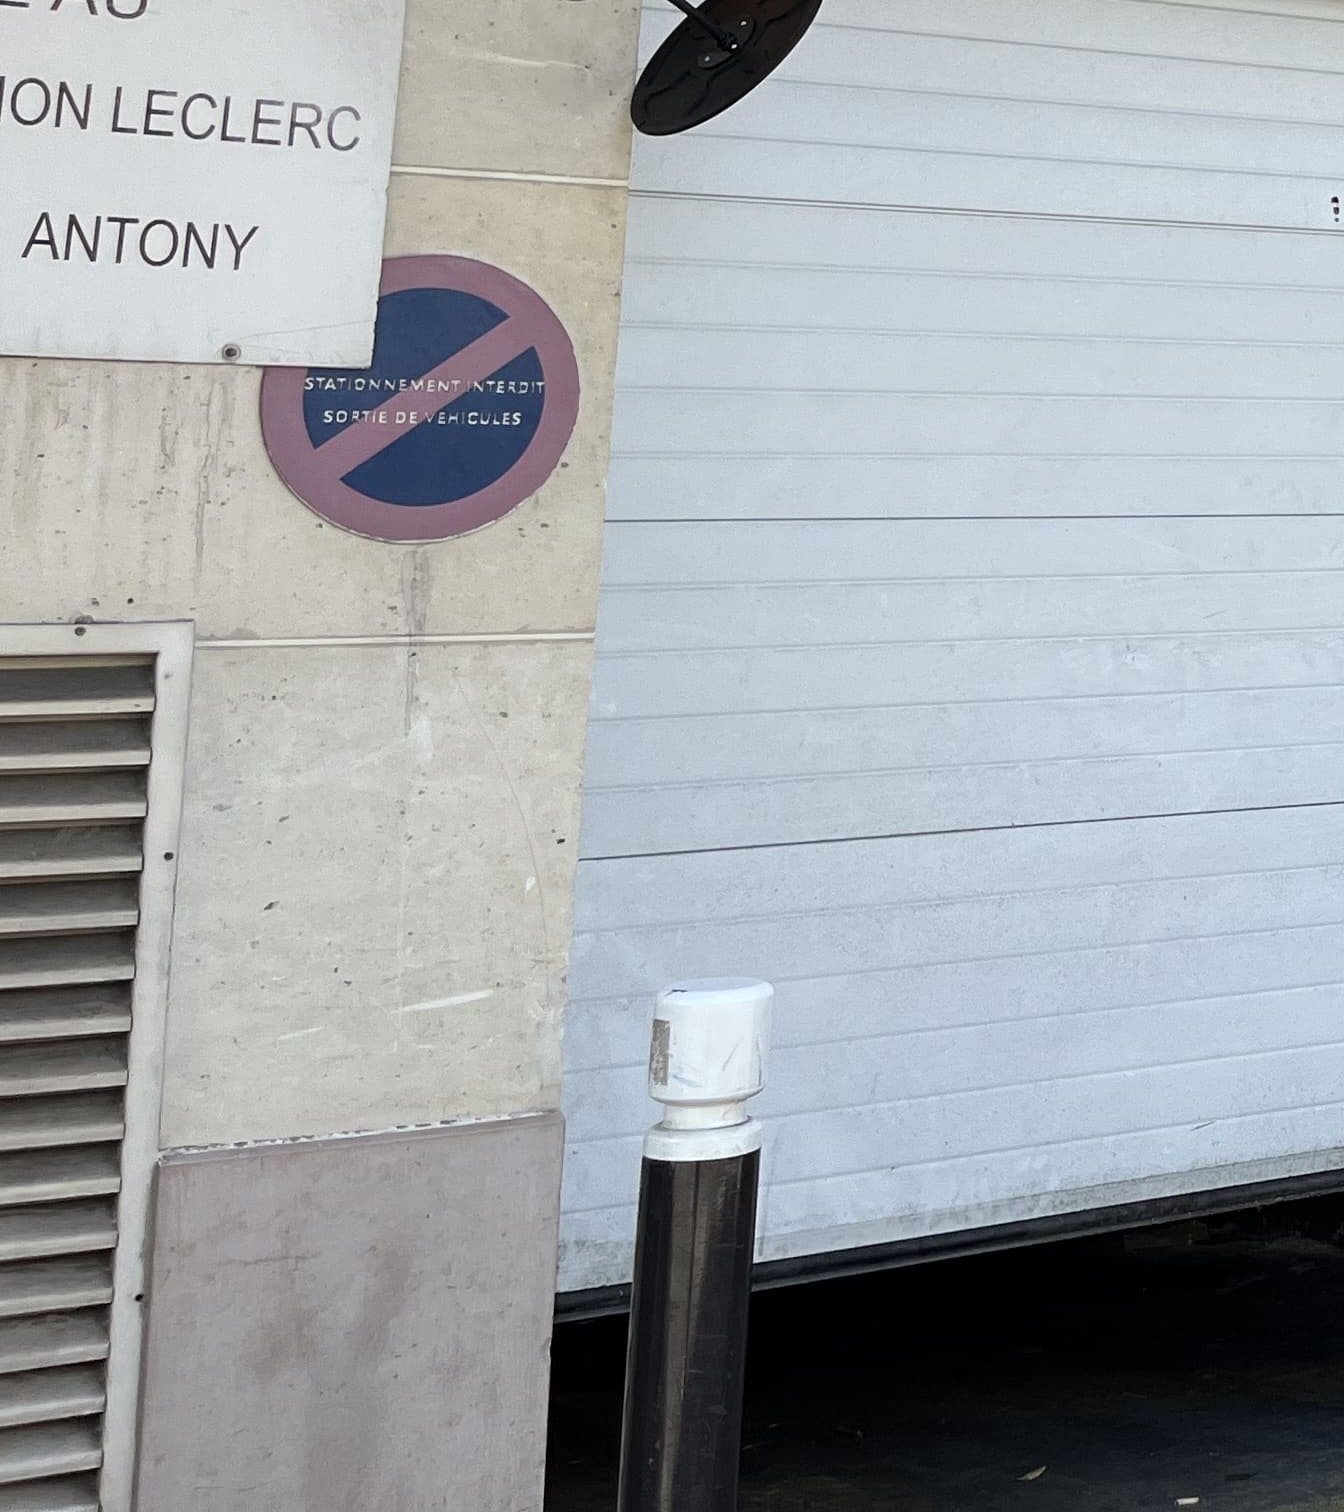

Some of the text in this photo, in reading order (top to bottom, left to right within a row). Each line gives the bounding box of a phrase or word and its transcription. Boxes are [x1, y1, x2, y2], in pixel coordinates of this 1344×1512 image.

[111, 86, 362, 152] LECLERC
[21, 211, 260, 271] ANTONY
[304, 377, 545, 394] STATIONNEMENT INTERDIT
[323, 409, 522, 426] SORTIE DE VEHICULES
